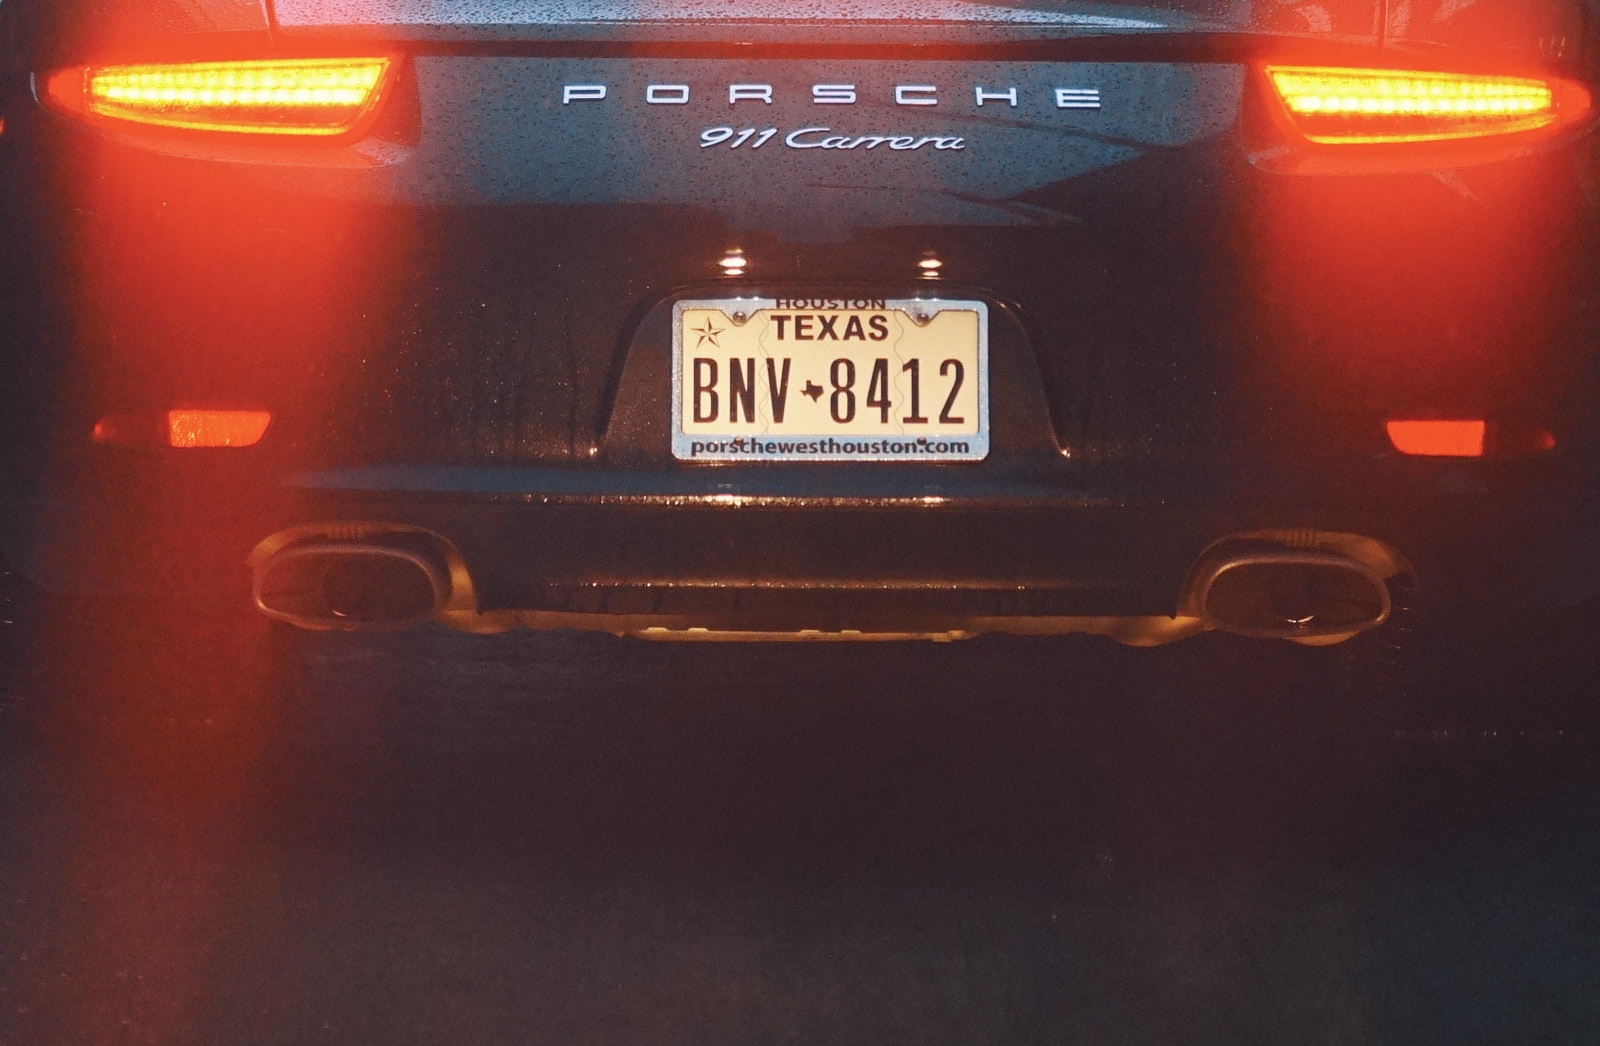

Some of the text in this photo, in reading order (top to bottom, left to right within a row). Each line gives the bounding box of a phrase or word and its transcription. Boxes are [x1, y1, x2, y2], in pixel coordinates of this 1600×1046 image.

[563, 84, 1100, 108] PORSCHE
[699, 127, 966, 151] 911 Carrera
[776, 298, 886, 309] HOUSTON
[770, 315, 889, 341] TEXAS
[693, 357, 965, 424] BNV 8412
[691, 437, 970, 457] porschewesthouston.com
